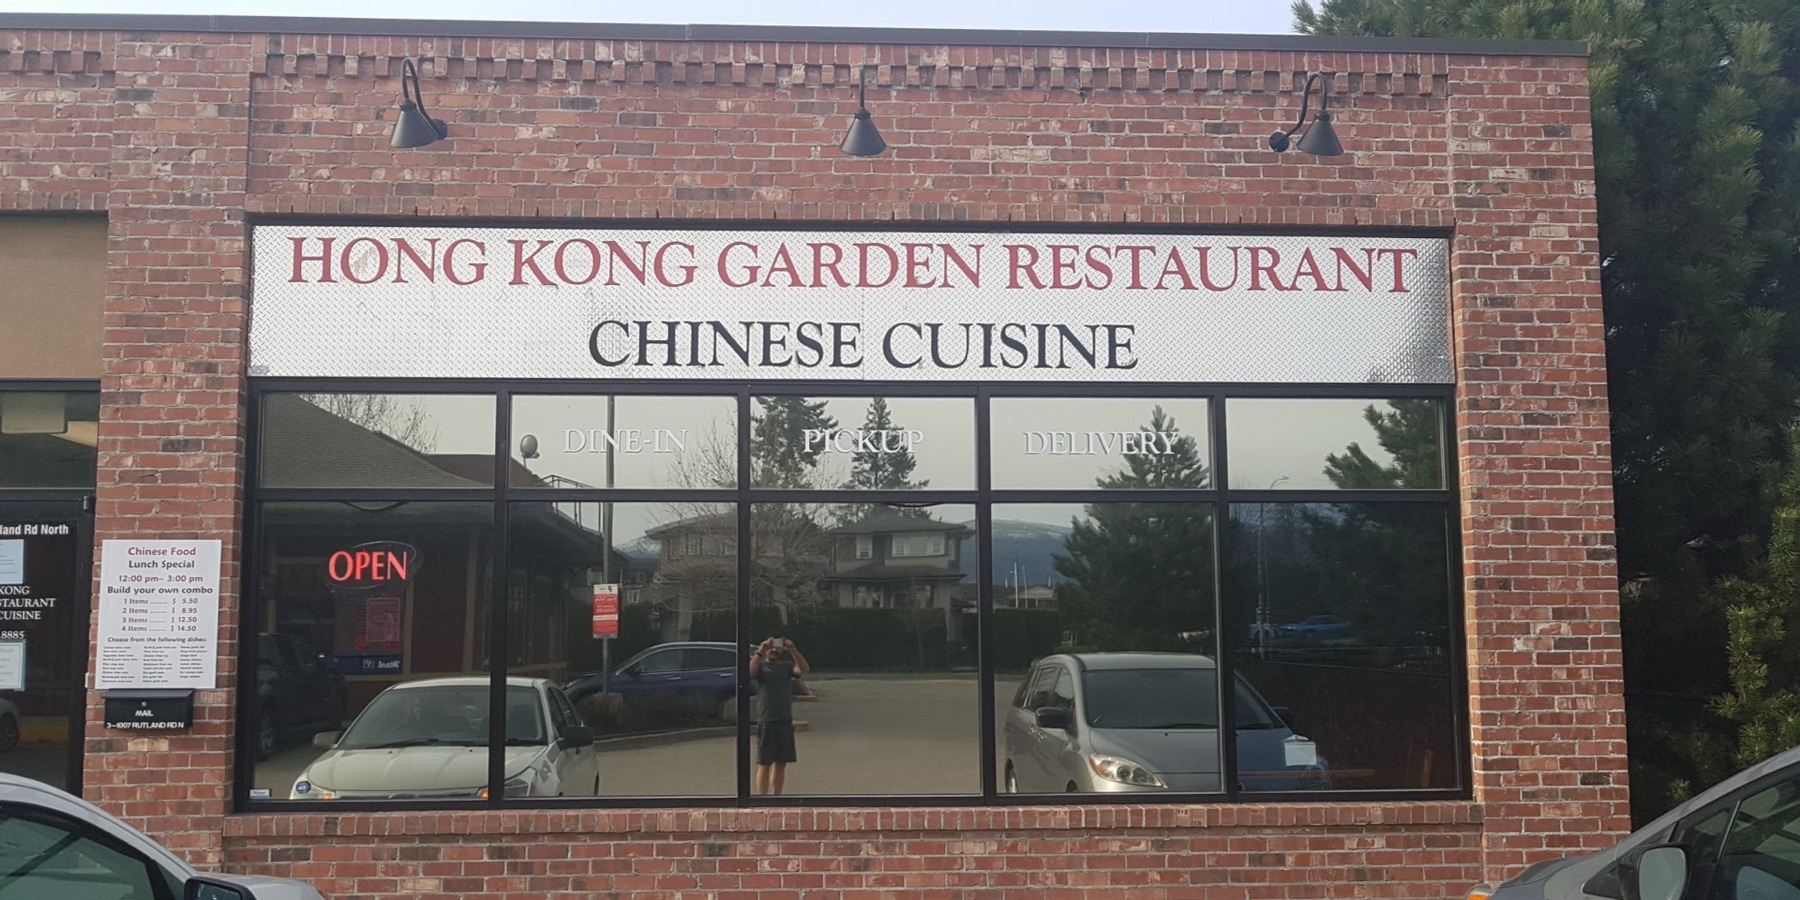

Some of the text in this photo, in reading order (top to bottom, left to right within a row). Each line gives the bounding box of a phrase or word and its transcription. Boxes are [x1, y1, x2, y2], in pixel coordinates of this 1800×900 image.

[288, 237, 1418, 294] HONG KONG GARDEN RESTAURANT
[588, 319, 1138, 370] CHINESE CUISINE
[562, 428, 689, 454] DINE-IN
[801, 428, 925, 453] PICKUP
[1022, 430, 1179, 455] DELIVERY
[24, 524, 38, 535] Rd
[41, 524, 69, 535] North
[128, 547, 197, 556] Chinese Food
[128, 560, 195, 570] Lunch Special
[328, 551, 408, 581] OPEN
[107, 586, 131, 594] Build
[181, 586, 213, 594] combo
